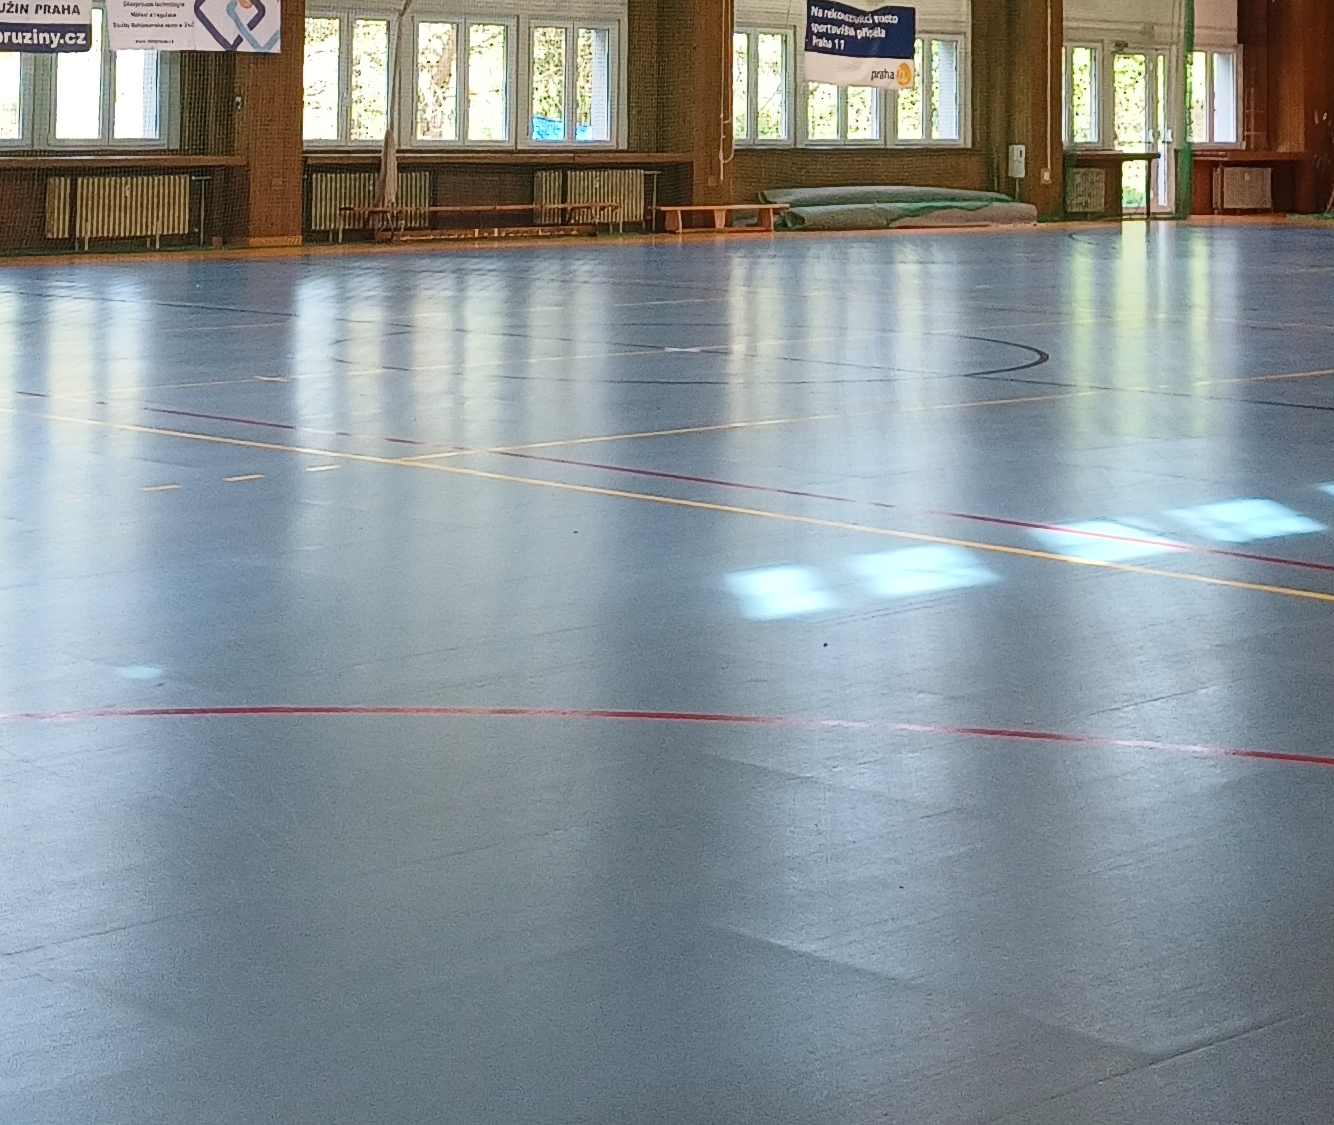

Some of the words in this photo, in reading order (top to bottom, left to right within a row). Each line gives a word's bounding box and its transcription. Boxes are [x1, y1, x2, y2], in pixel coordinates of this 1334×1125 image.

[34, 4, 81, 16] PRAHA
[810, 5, 823, 18] Na
[834, 38, 845, 51] 11
[870, 68, 895, 82] praha
